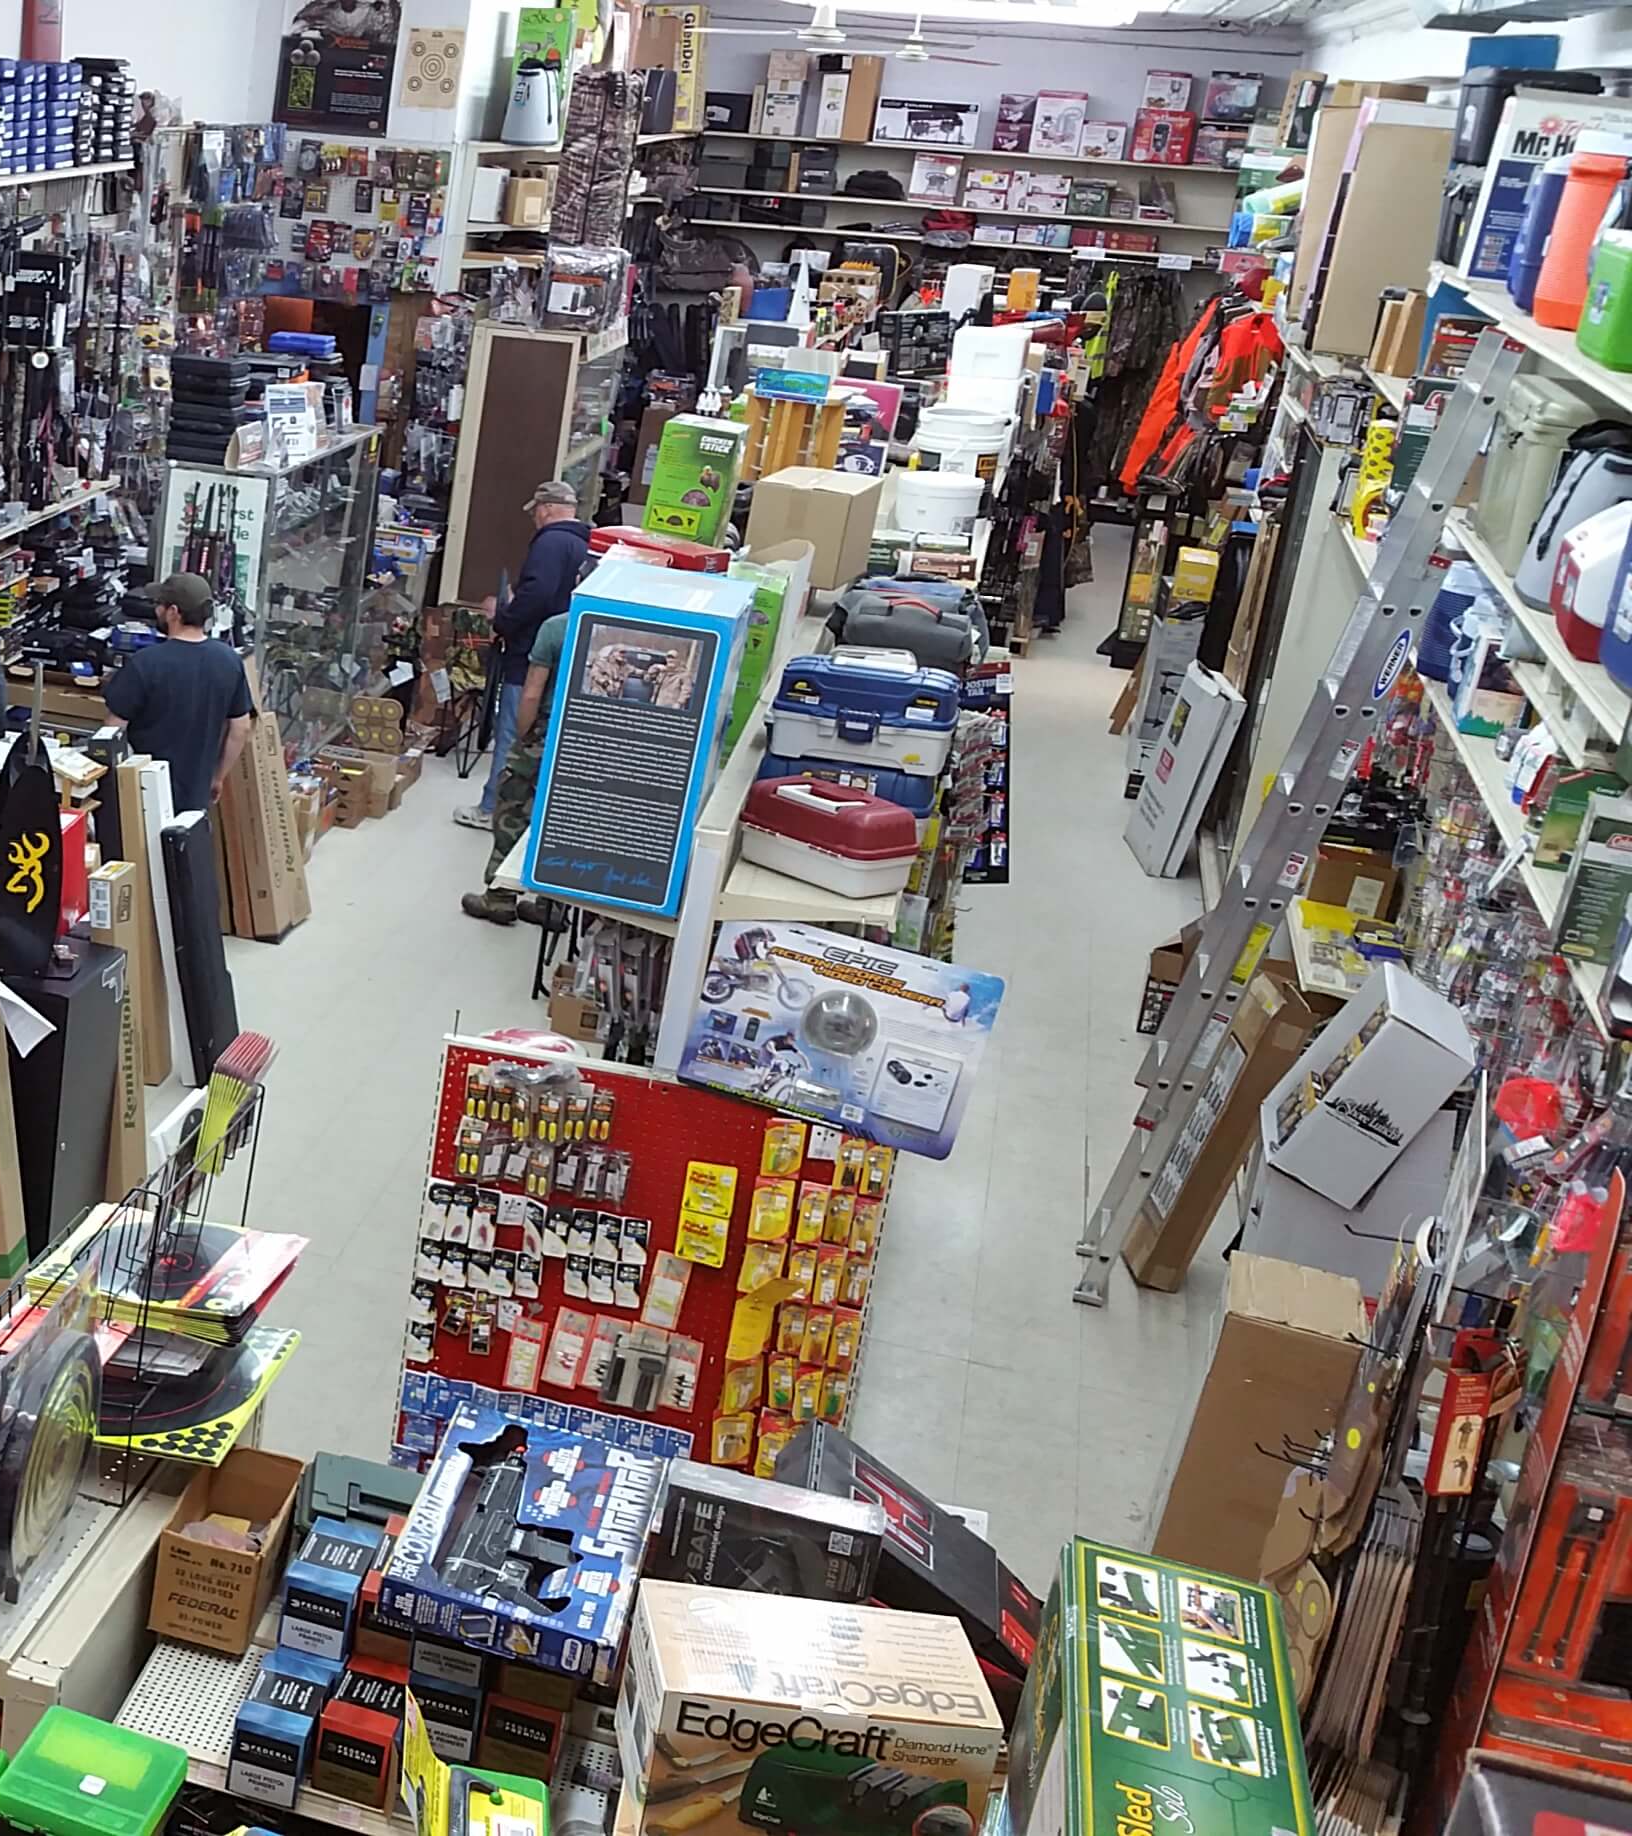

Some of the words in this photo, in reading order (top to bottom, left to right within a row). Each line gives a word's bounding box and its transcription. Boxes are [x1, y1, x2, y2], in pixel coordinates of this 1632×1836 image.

[681, 12, 696, 74] GlenDel
[1512, 131, 1549, 156] Mr.
[1378, 642, 1406, 686] WERNER
[270, 769, 297, 874] Remington
[770, 946, 830, 970] ACTION
[830, 961, 908, 988] SPORTS
[822, 946, 899, 976] EPIC
[812, 966, 866, 987] VIDEO
[867, 979, 946, 1008] CAMERA
[122, 986, 137, 1130] Remington
[713, 1504, 727, 1533] design
[687, 1501, 714, 1571] SAFE
[209, 1557, 227, 1570] No.
[229, 1561, 252, 1575] 710
[401, 1554, 421, 1582] FOR
[178, 1578, 235, 1600] CARTRIDGES
[216, 1580, 241, 1591] RIFLE
[168, 1592, 240, 1620] FEDERAL
[301, 1601, 343, 1618] FEDERAL
[290, 1624, 312, 1636] LARGE
[426, 1699, 471, 1717] FEDERAL
[777, 1671, 988, 1721] EdgeCraft
[434, 1729, 468, 1743] MAGNUM
[505, 1726, 547, 1743] PREMIUM
[506, 1721, 546, 1737] FEDERAL
[676, 1700, 892, 1760] EdgeCraft
[250, 1744, 294, 1762] FEDERAL
[337, 1743, 377, 1761] FEDERAL
[337, 1749, 378, 1766] PREMIUM
[892, 1750, 958, 1767] Sharpener
[894, 1737, 952, 1755] Diamond
[954, 1742, 988, 1756] Hone
[240, 1769, 262, 1782] LARGE
[1115, 1781, 1154, 1836] Sled
[1143, 1783, 1194, 1834] Solo
